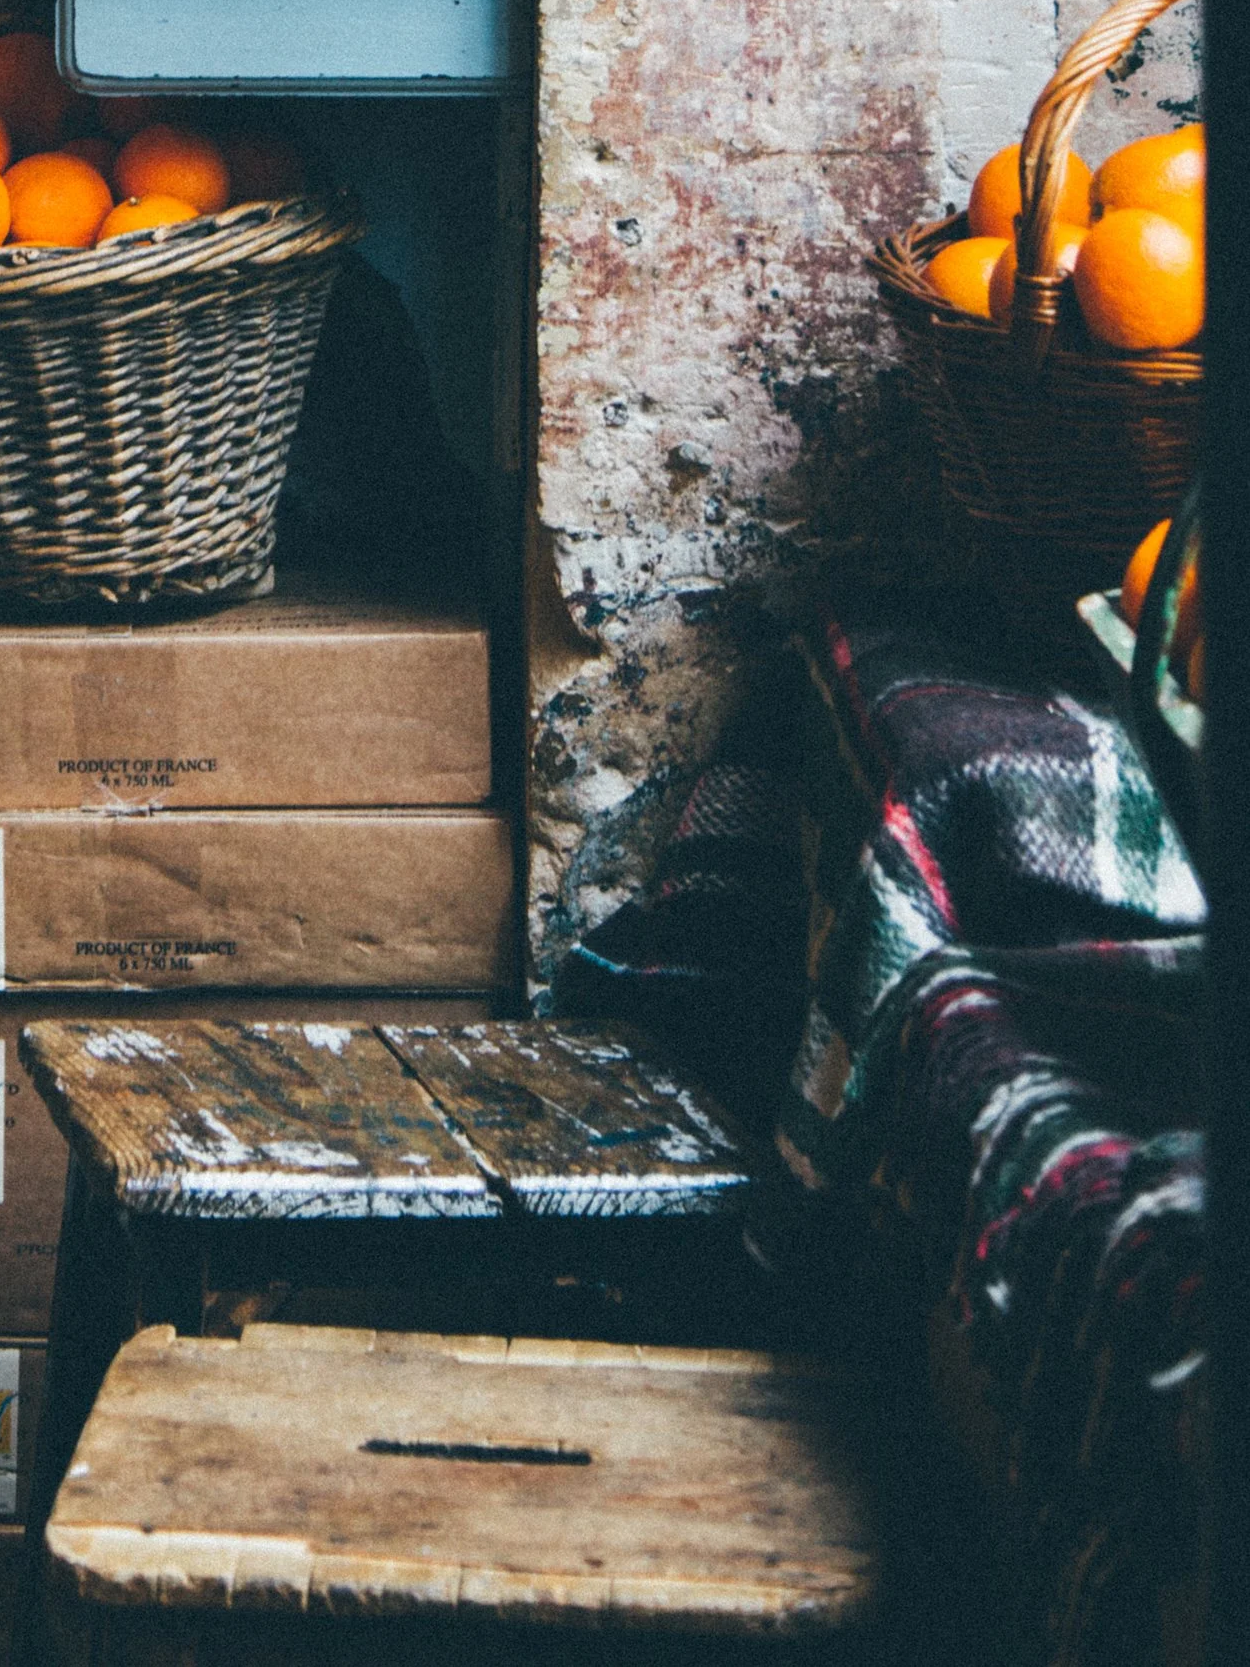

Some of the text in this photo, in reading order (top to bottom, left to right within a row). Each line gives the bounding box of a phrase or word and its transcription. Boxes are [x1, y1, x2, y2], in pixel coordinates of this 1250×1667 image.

[58, 758, 217, 773] PRODUCT OF FRANCE
[126, 775, 148, 786] 750
[151, 775, 174, 786] ML
[76, 941, 237, 955] PRODUCT OF FRANCE
[144, 957, 166, 970] 750
[170, 957, 193, 970] ML
